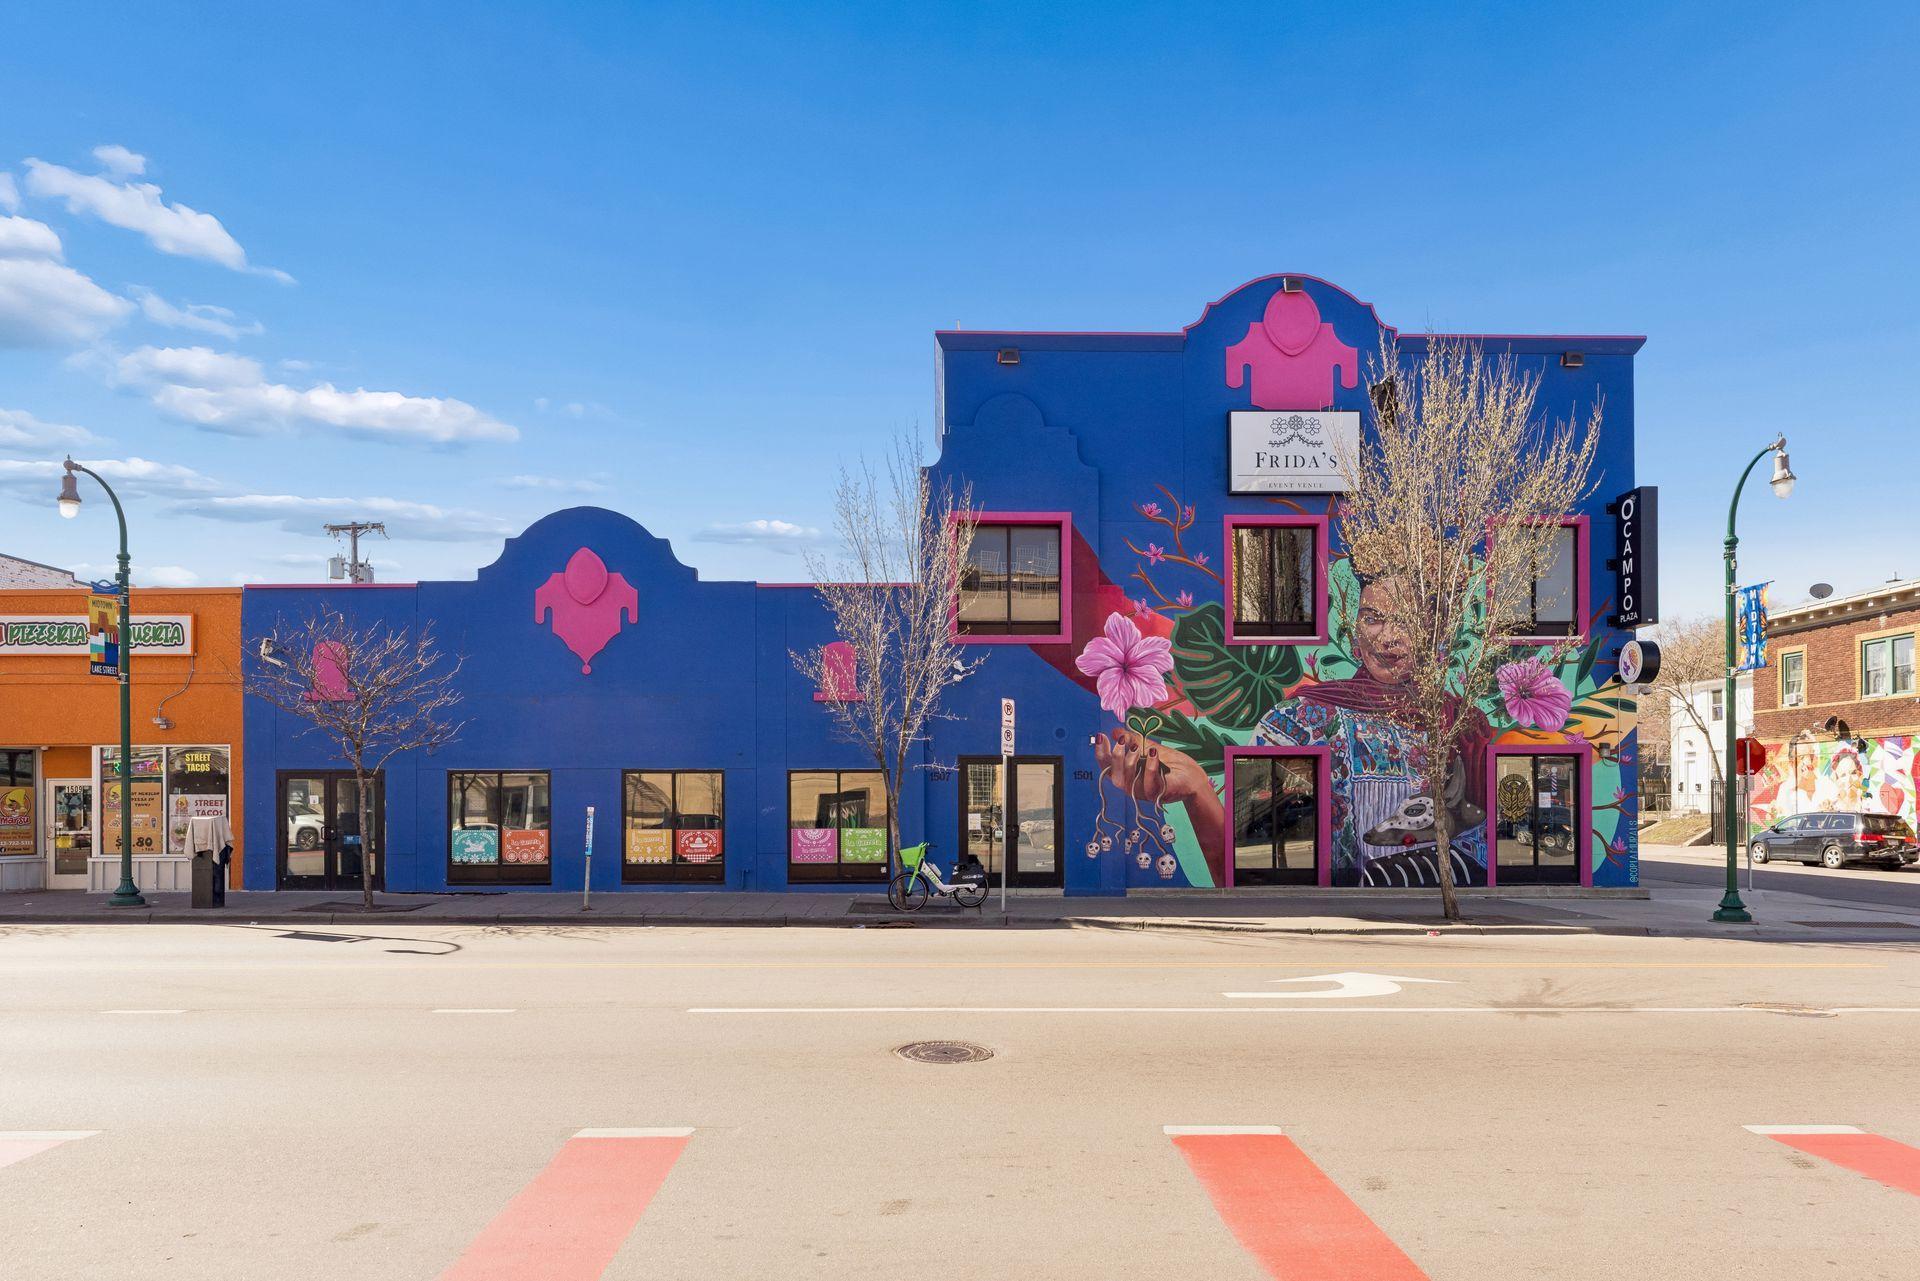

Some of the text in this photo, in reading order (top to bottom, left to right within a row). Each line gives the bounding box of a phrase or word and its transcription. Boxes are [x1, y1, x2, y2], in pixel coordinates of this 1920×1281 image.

[1255, 451, 1338, 469] FRIDA'S
[1621, 498, 1635, 611] OCAMPO
[91, 599, 113, 609] MIDTOWN
[1620, 611, 1639, 623] PLAZA
[1749, 589, 1758, 665] MIDTOWN
[8, 624, 88, 644] PIZZERIA
[91, 664, 118, 675] LAKE STREET
[185, 753, 211, 762] STREET
[187, 763, 211, 772] TACOS
[930, 771, 950, 782] 1507
[1073, 770, 1093, 781] 1501
[66, 785, 83, 793] 1509
[194, 799, 225, 807] STREET
[195, 809, 223, 817] TACOS
